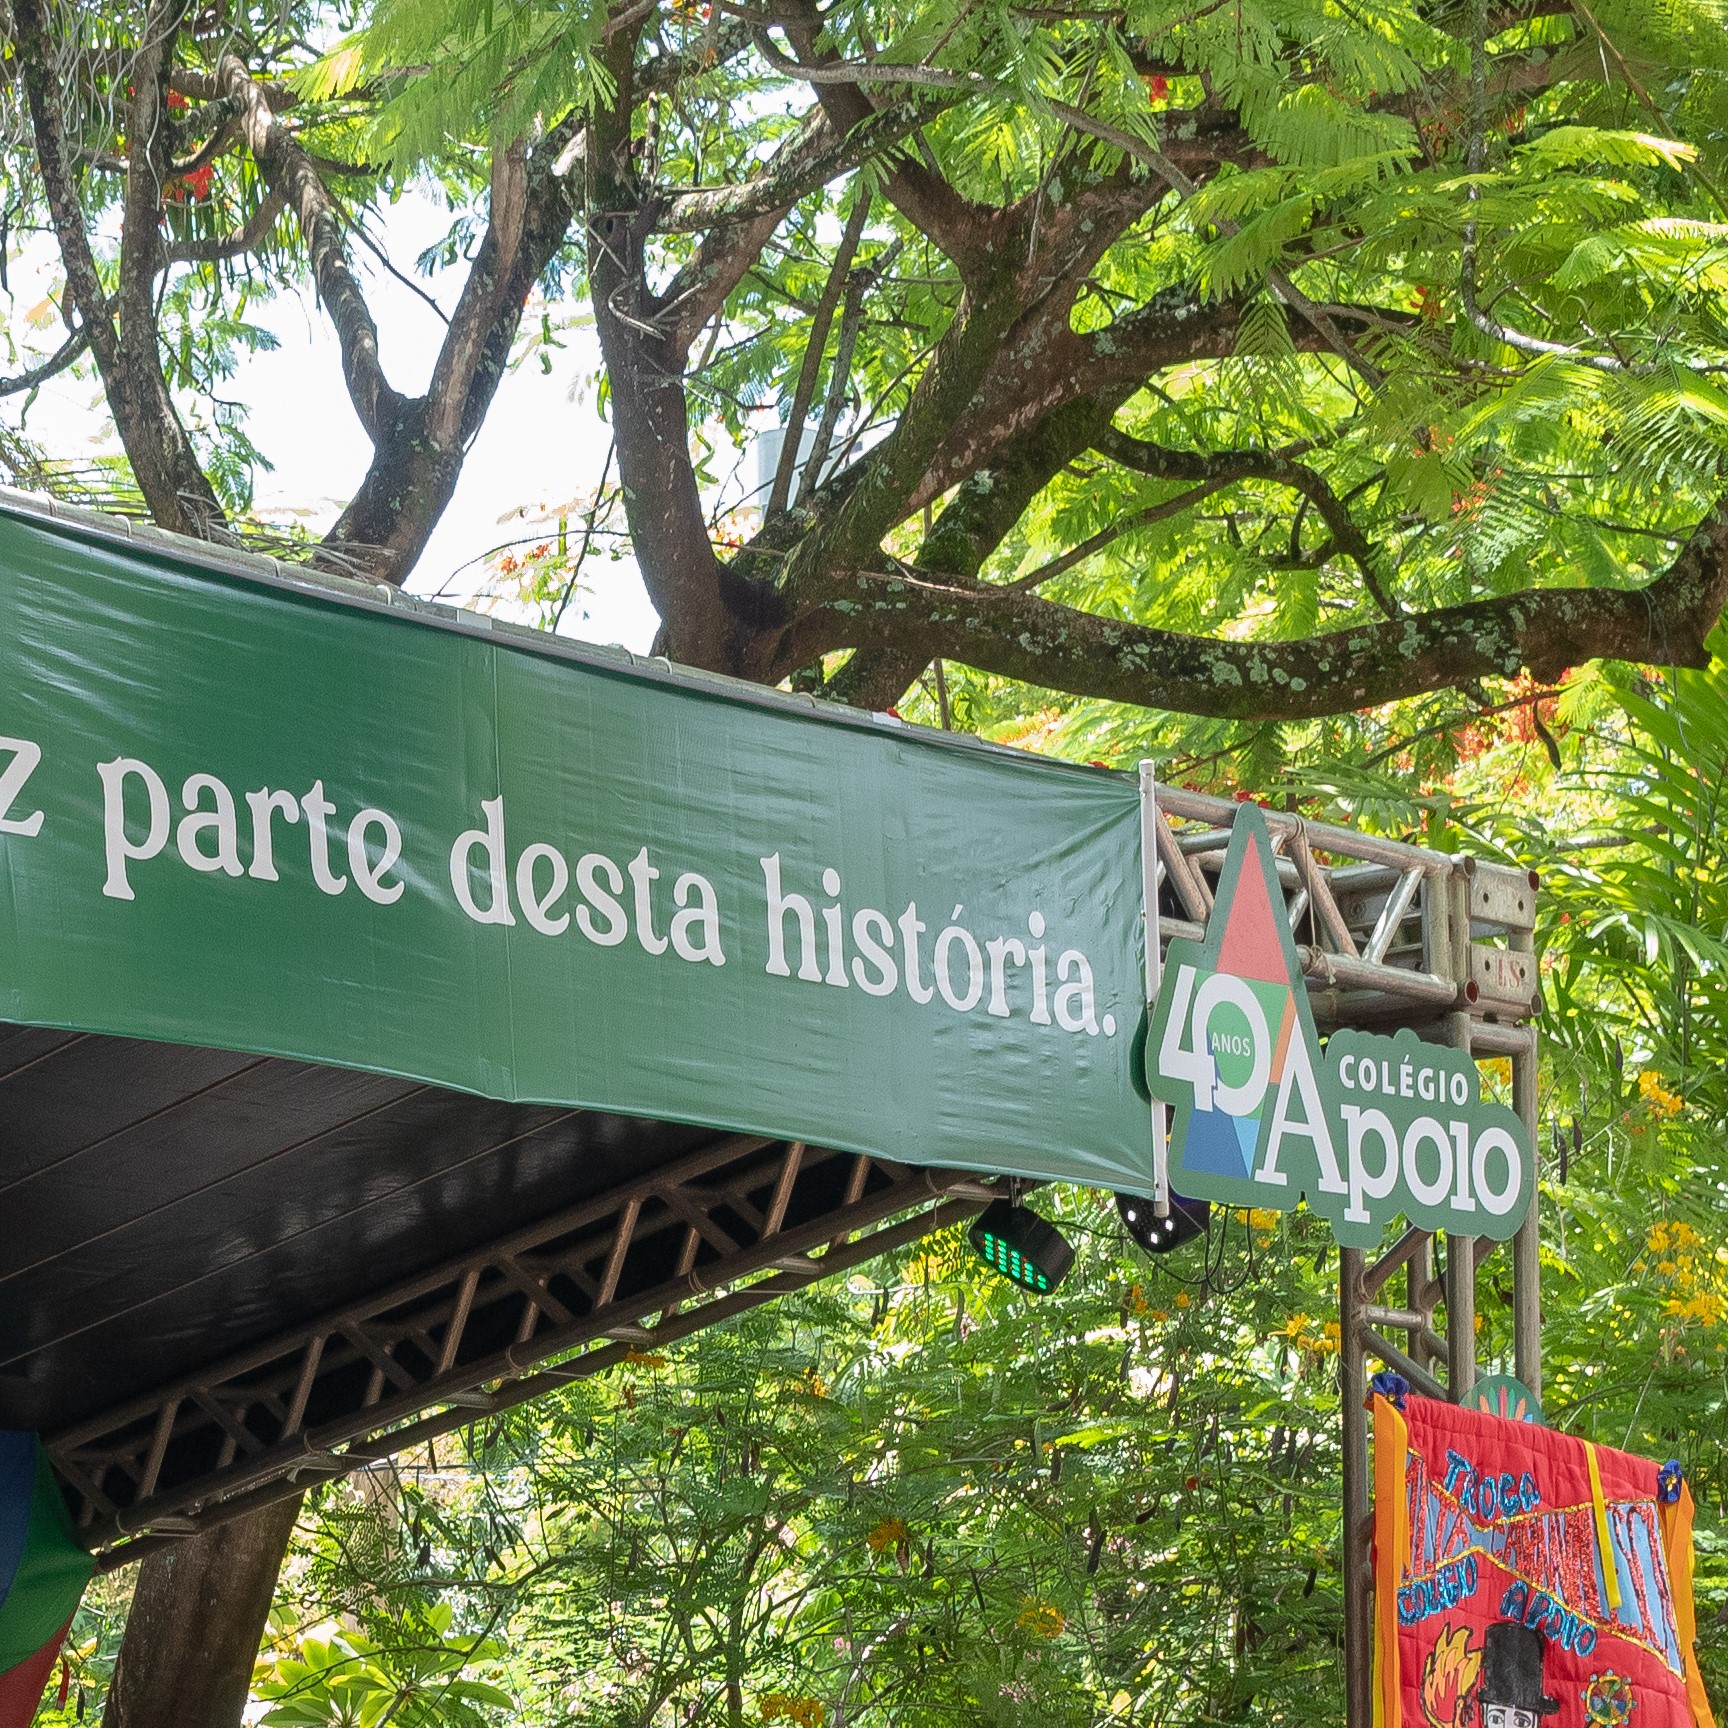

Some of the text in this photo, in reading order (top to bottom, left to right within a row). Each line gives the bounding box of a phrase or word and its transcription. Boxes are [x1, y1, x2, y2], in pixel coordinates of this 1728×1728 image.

[96, 755, 406, 906] parte
[449, 794, 727, 968] desta
[761, 851, 1119, 1039] história.
[1158, 964, 1271, 1118] 40
[1211, 1031, 1252, 1058] ANOS
[1338, 1053, 1469, 1106] COLÉGIO
[1254, 1014, 1522, 1226] Apoio
[1499, 1579, 1598, 1658] APOIO
